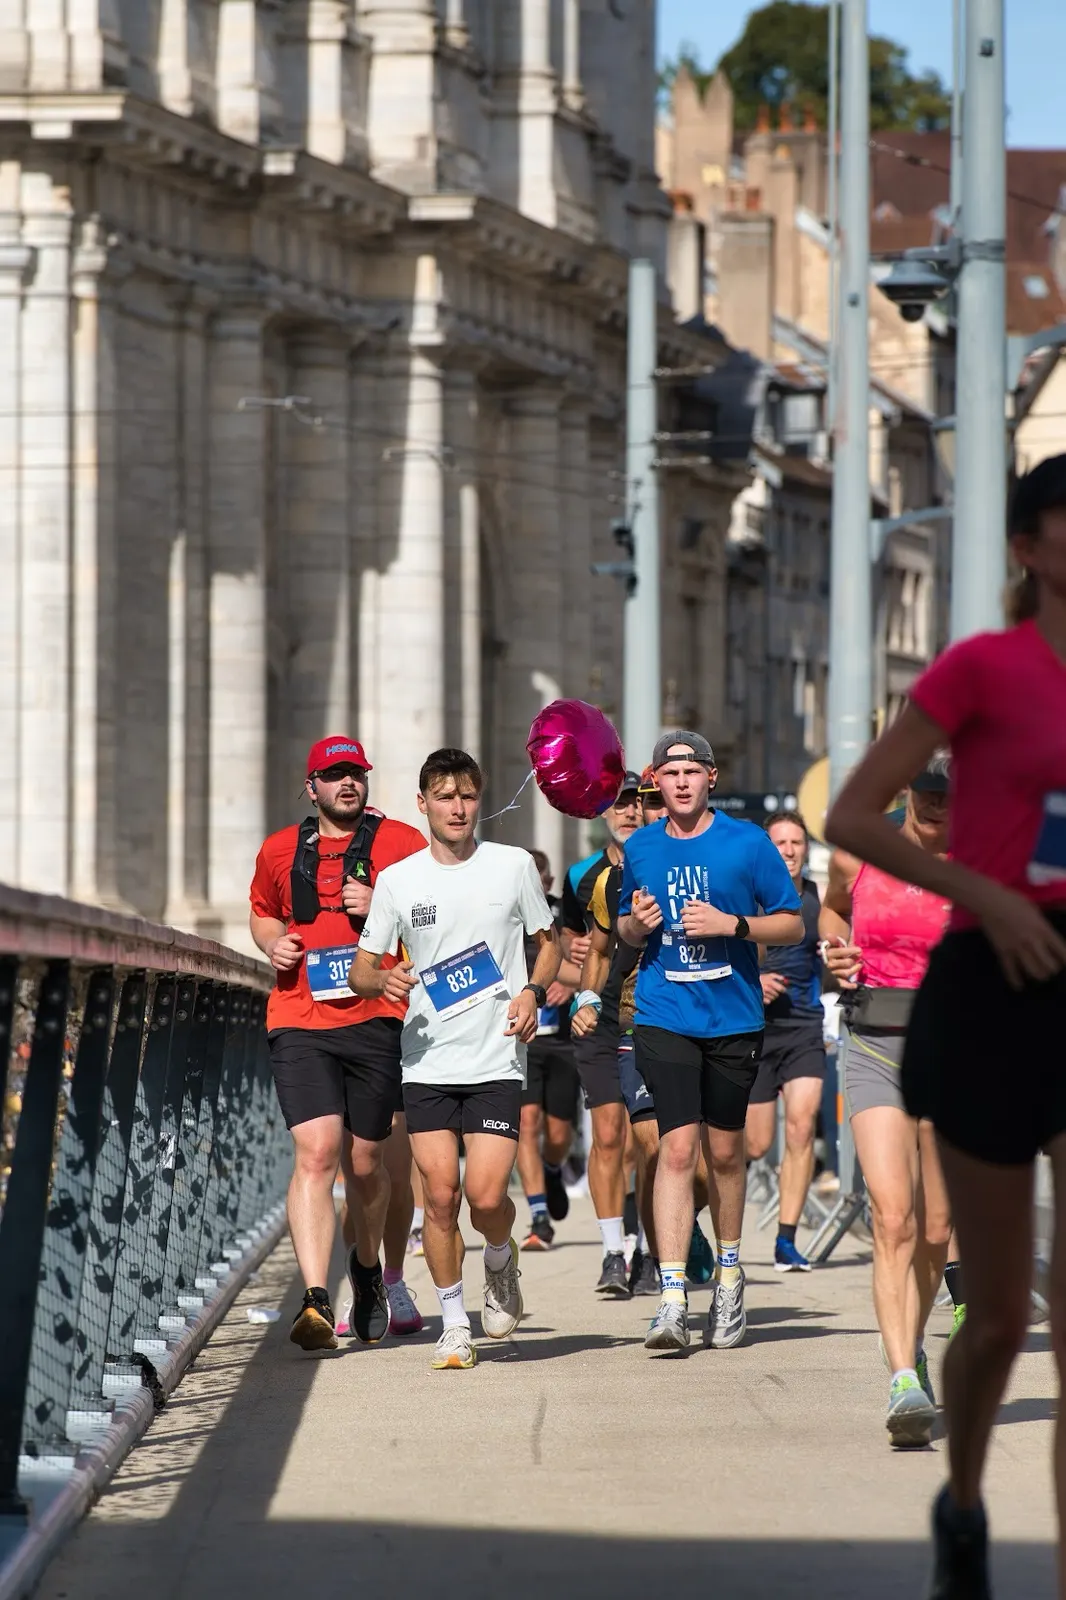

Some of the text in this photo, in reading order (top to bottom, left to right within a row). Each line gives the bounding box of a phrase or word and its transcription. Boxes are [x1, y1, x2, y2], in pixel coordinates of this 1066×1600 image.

[326, 744, 359, 757] HOKA
[679, 944, 708, 964] 822
[328, 959, 352, 981] 315
[446, 965, 478, 993] 832
[482, 1119, 510, 1131] VELCAP
